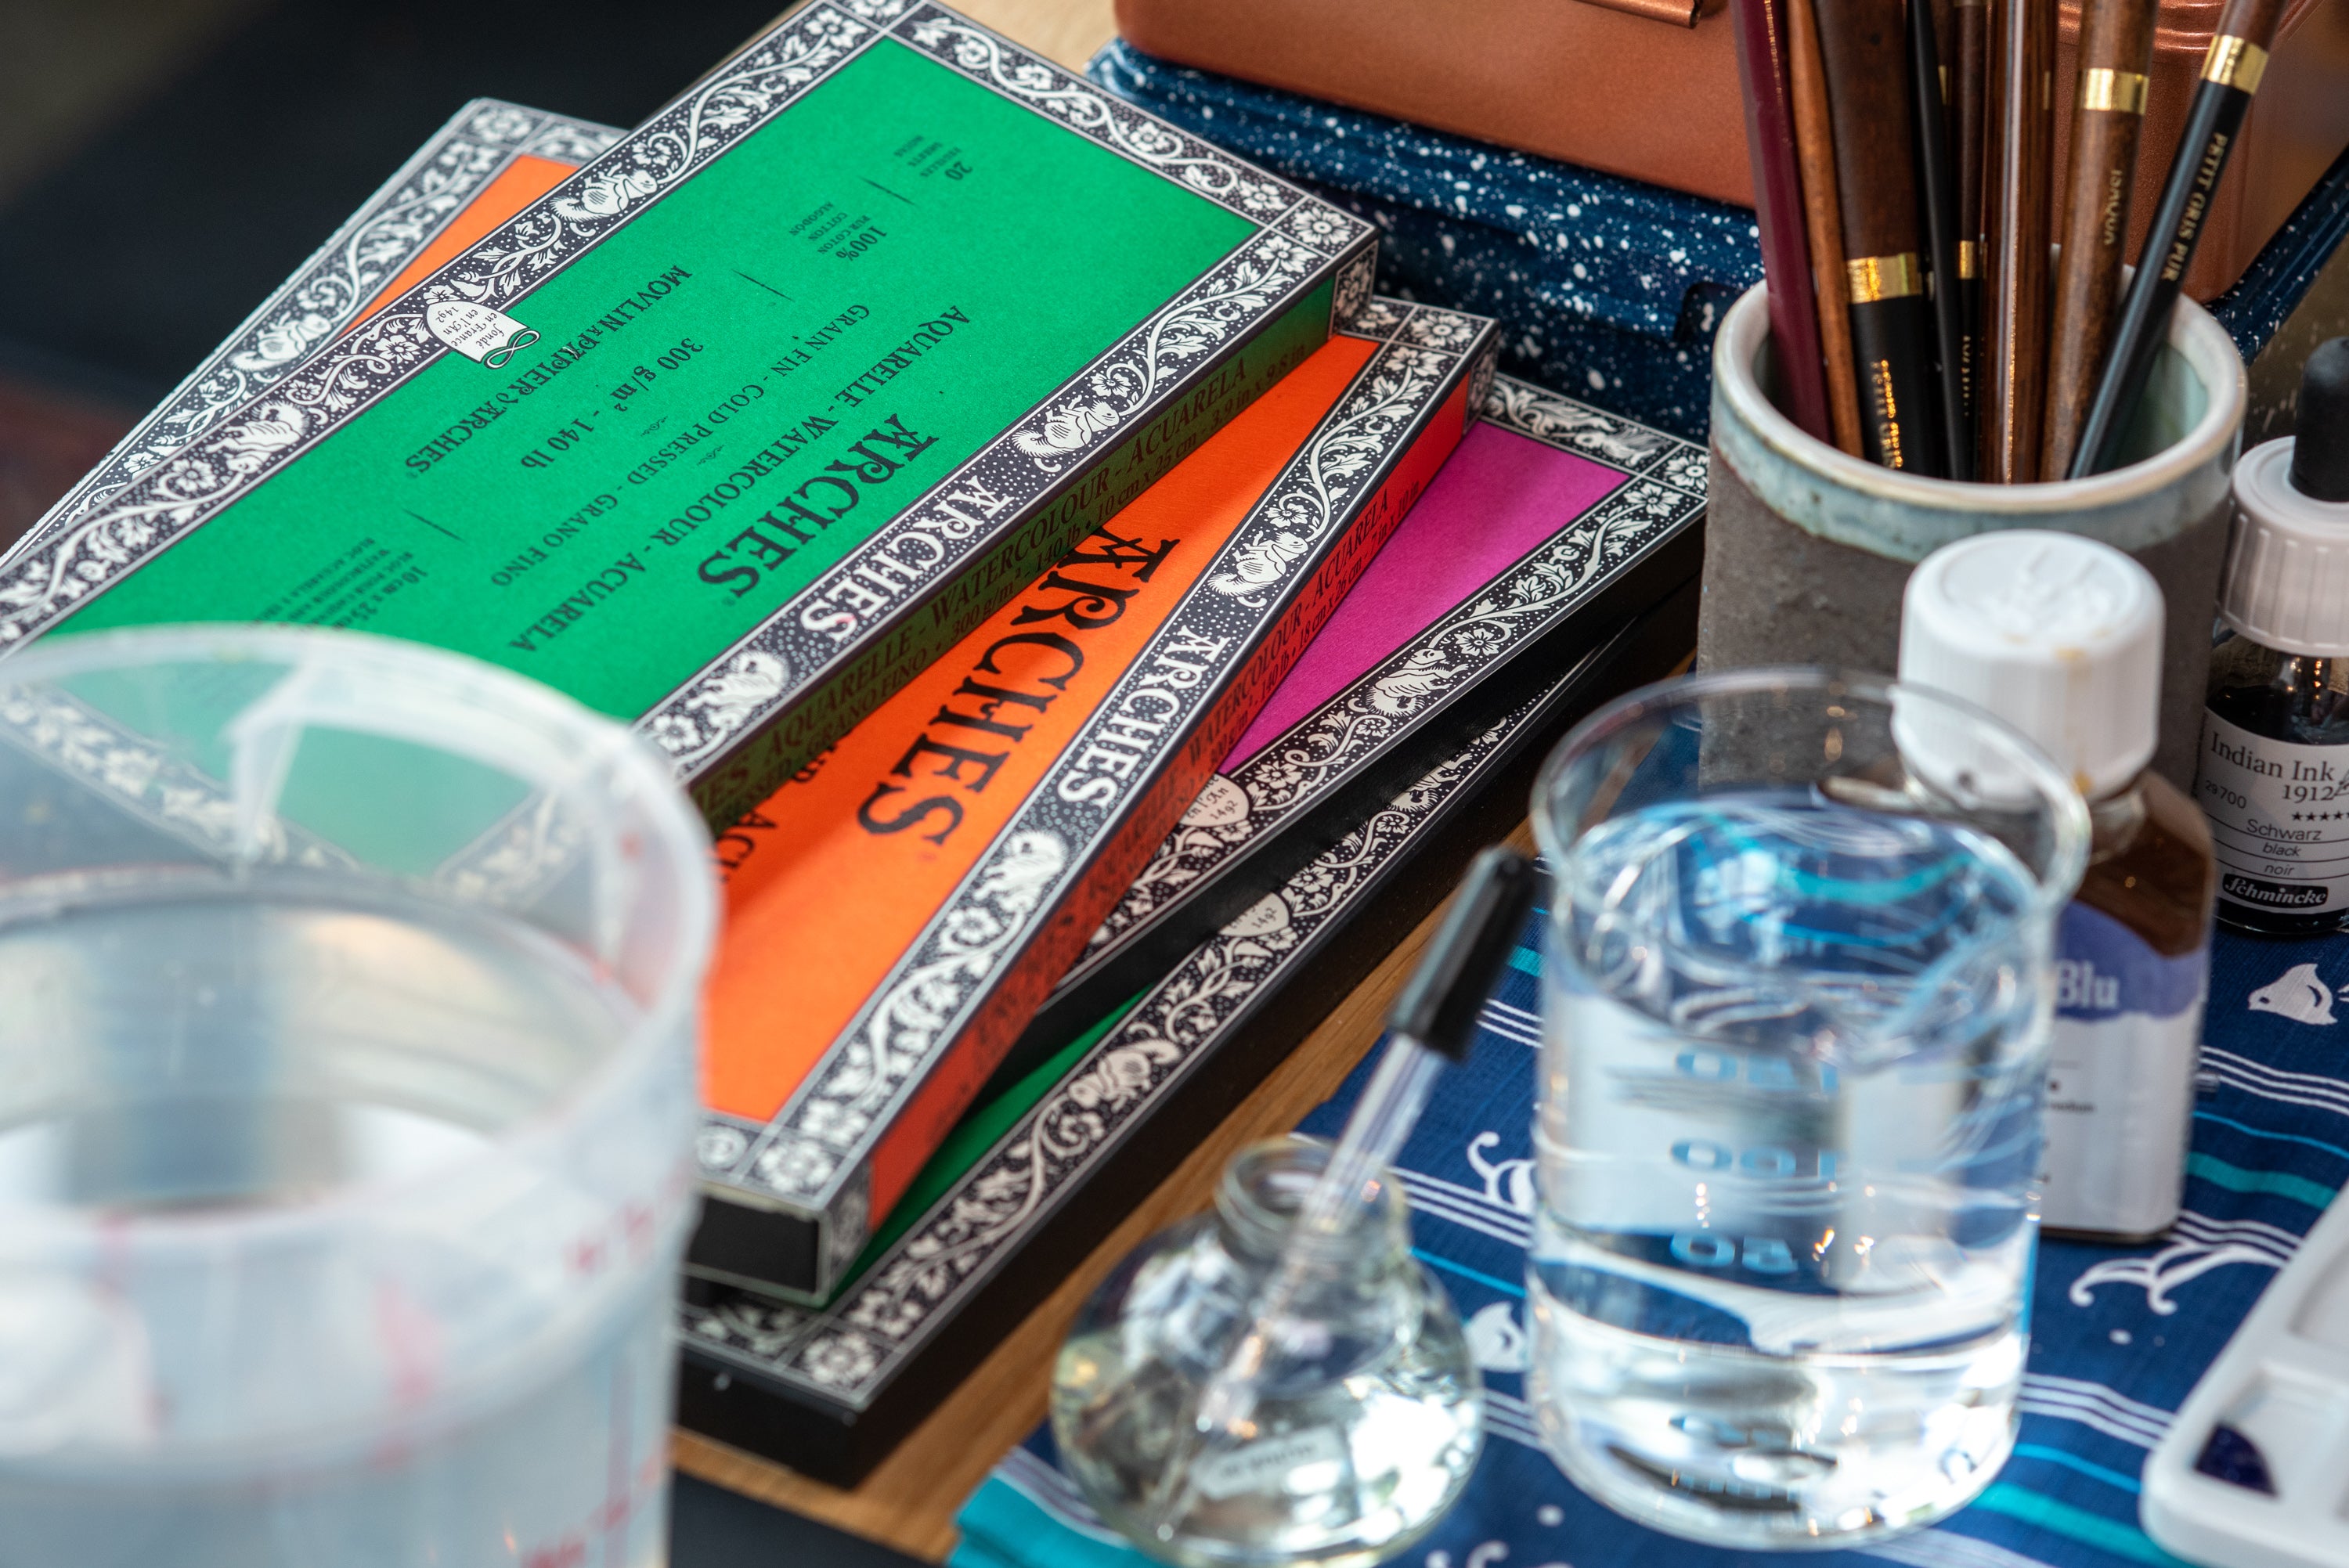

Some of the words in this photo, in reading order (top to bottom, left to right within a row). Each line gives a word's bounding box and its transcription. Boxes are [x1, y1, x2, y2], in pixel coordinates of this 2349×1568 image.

[944, 160, 972, 181] 20
[788, 202, 834, 236] ALGODÓN
[807, 212, 848, 242] COTTON
[849, 214, 871, 230] PUR
[817, 229, 852, 254] COTON
[835, 225, 887, 261] 100%
[2161, 243, 2188, 282] PUR
[465, 309, 478, 319] en
[597, 265, 693, 332] MOVLIN
[451, 323, 487, 347] France
[484, 312, 497, 323] en
[804, 305, 870, 351] GRAIN
[475, 323, 505, 349] fondé
[656, 337, 704, 370] 300
[770, 348, 813, 377] FIN
[834, 305, 970, 408] AQUARELLE
[708, 384, 764, 424] COLD
[547, 418, 594, 451] 140
[521, 449, 555, 468] lb
[627, 423, 714, 485] PRESSED
[650, 416, 839, 546] WATERCOLOUR
[931, 465, 1110, 626] WATERCOLOUR
[1128, 356, 1246, 467] ACUARELA
[543, 494, 619, 548] GRANO
[698, 413, 940, 598] ARCHES
[952, 607, 980, 640] 300
[1036, 543, 1063, 571] 140
[1066, 521, 1081, 546] lb
[1099, 497, 1114, 521] 10
[1118, 481, 1138, 505] cm
[1143, 472, 1152, 484] x
[1155, 452, 1172, 474] 25
[1178, 434, 1196, 456] cm
[1212, 403, 1233, 427] 3.9
[1237, 386, 1250, 406] in
[799, 475, 1016, 643] ARCHES
[1314, 487, 1388, 599] ACUARELA
[491, 546, 548, 586] FINO
[509, 552, 646, 651] ACUARELA
[1262, 666, 1278, 697] 140
[1281, 647, 1289, 674] lb
[1300, 621, 1311, 647] 18
[1312, 605, 1326, 632] cm
[1329, 593, 1333, 611] x
[1336, 573, 1347, 600] 26
[1348, 557, 1362, 583] cm
[857, 527, 1181, 846] ARCHES
[1057, 625, 1232, 809] ARCHES
[2210, 732, 2283, 778] Indian
[2292, 760, 2335, 782] Ink
[2282, 784, 2335, 804] 1912
[1185, 807, 1200, 819] en
[2246, 819, 2322, 842] Schwarz
[2262, 842, 2302, 857] black
[2264, 863, 2295, 876] noir
[2225, 875, 2327, 904] Schmincke
